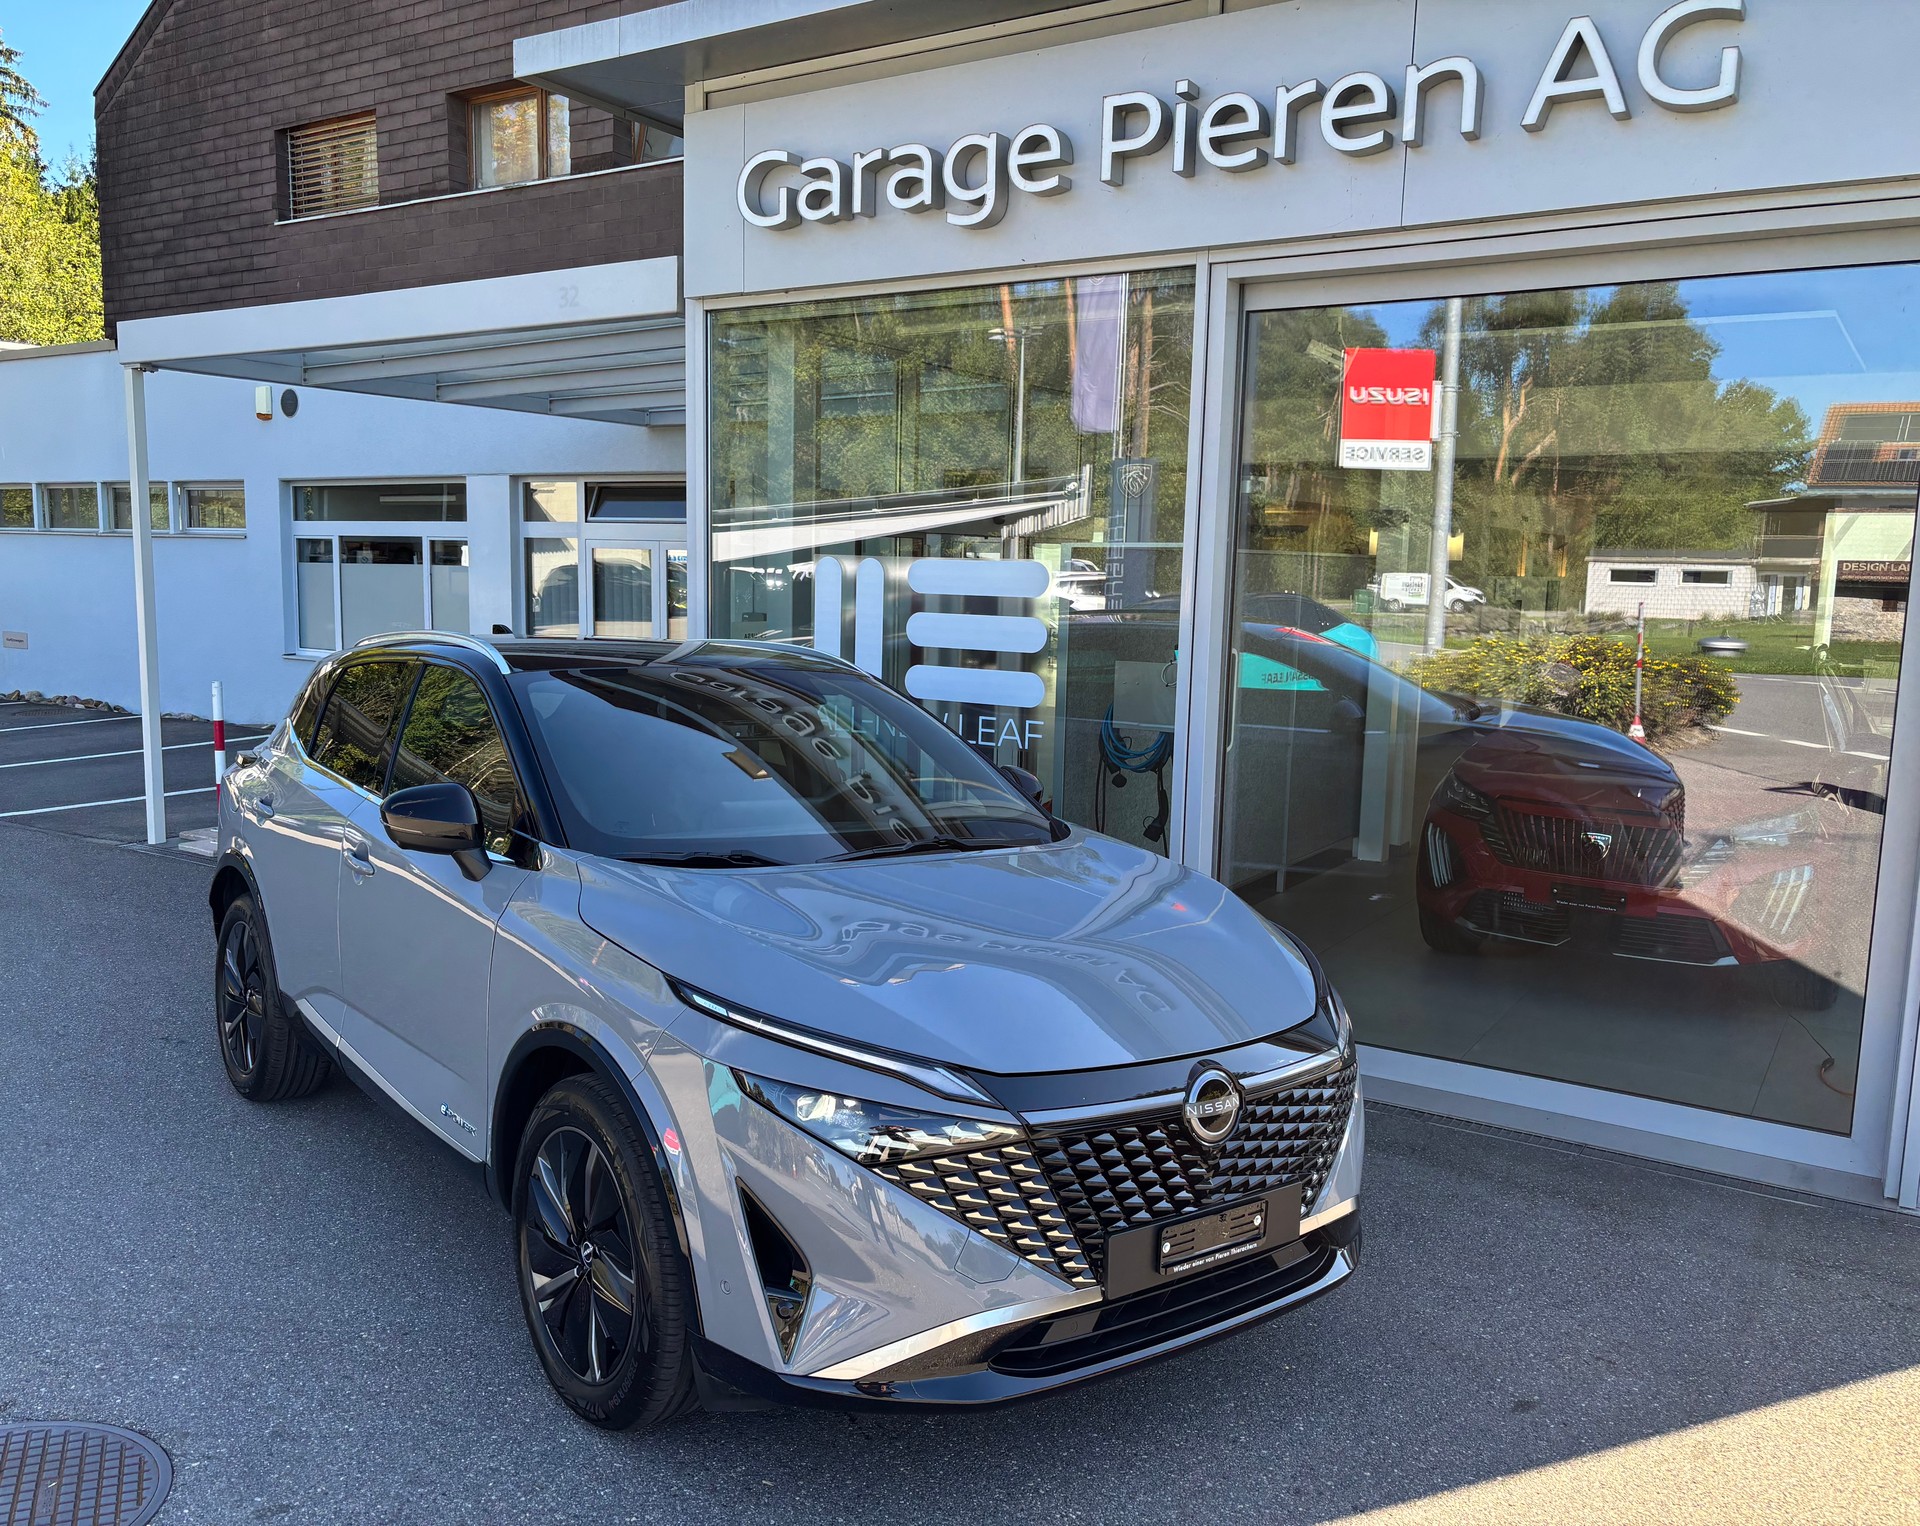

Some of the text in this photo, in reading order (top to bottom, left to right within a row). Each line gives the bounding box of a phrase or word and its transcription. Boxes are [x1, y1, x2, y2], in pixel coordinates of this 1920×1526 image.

[737, 0, 1747, 231] Garage Pieren AG
[559, 285, 580, 308] 32
[1842, 562, 1889, 572] DESIGN
[958, 712, 1046, 751] LEAF
[1186, 1096, 1239, 1116] NISSAN
[1173, 1263, 1191, 1273] Wieder
